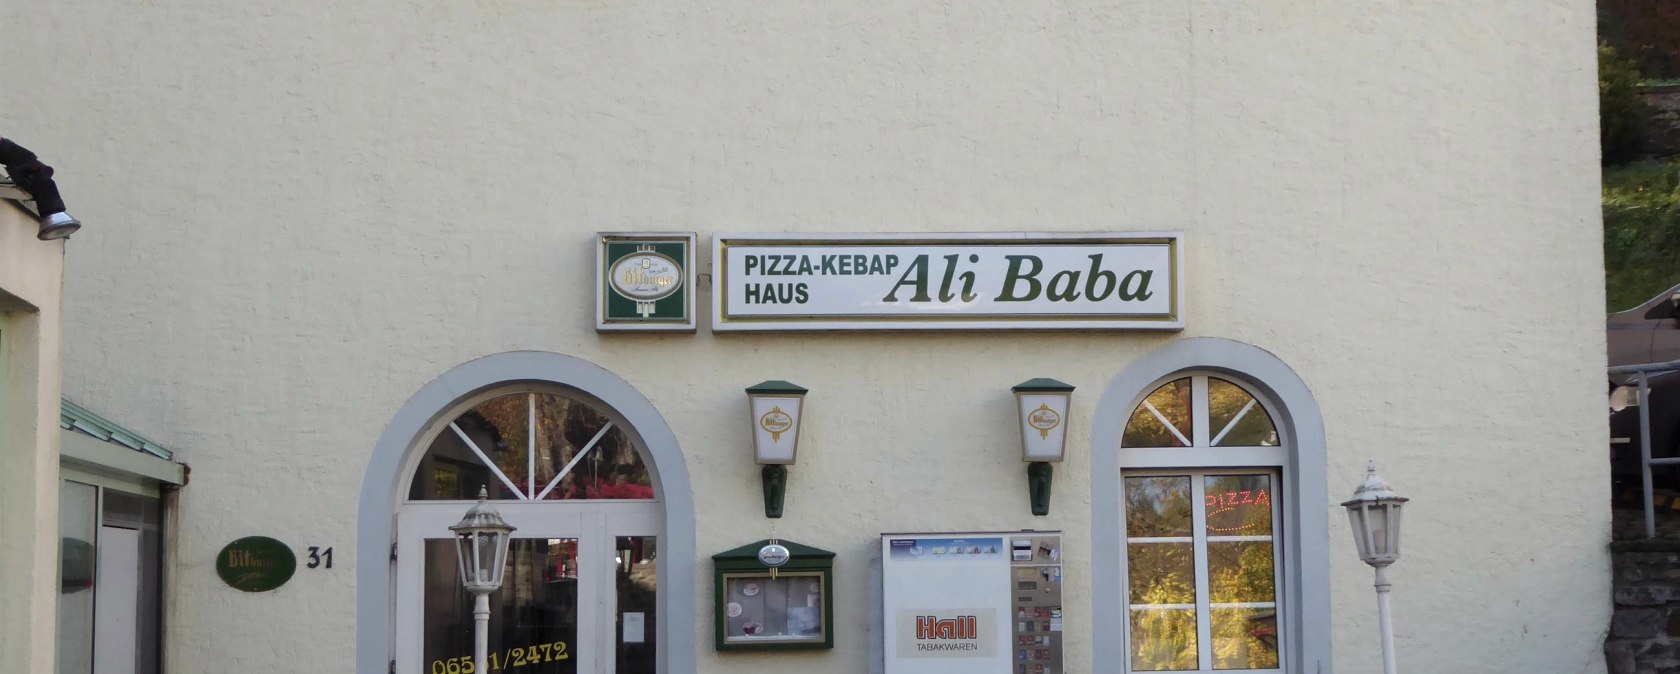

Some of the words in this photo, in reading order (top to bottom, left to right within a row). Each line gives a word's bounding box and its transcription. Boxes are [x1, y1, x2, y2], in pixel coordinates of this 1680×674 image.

[744, 254, 899, 276] PIZZA-KEBAP
[882, 253, 979, 303] Ali
[993, 253, 1154, 303] Baba
[744, 283, 810, 304] HAUS
[1204, 489, 1271, 511] PIZZA
[306, 546, 334, 569] 31
[916, 615, 978, 640] Hall
[432, 641, 569, 674] 0651/2472
[916, 643, 978, 651] TABAKWAREN
